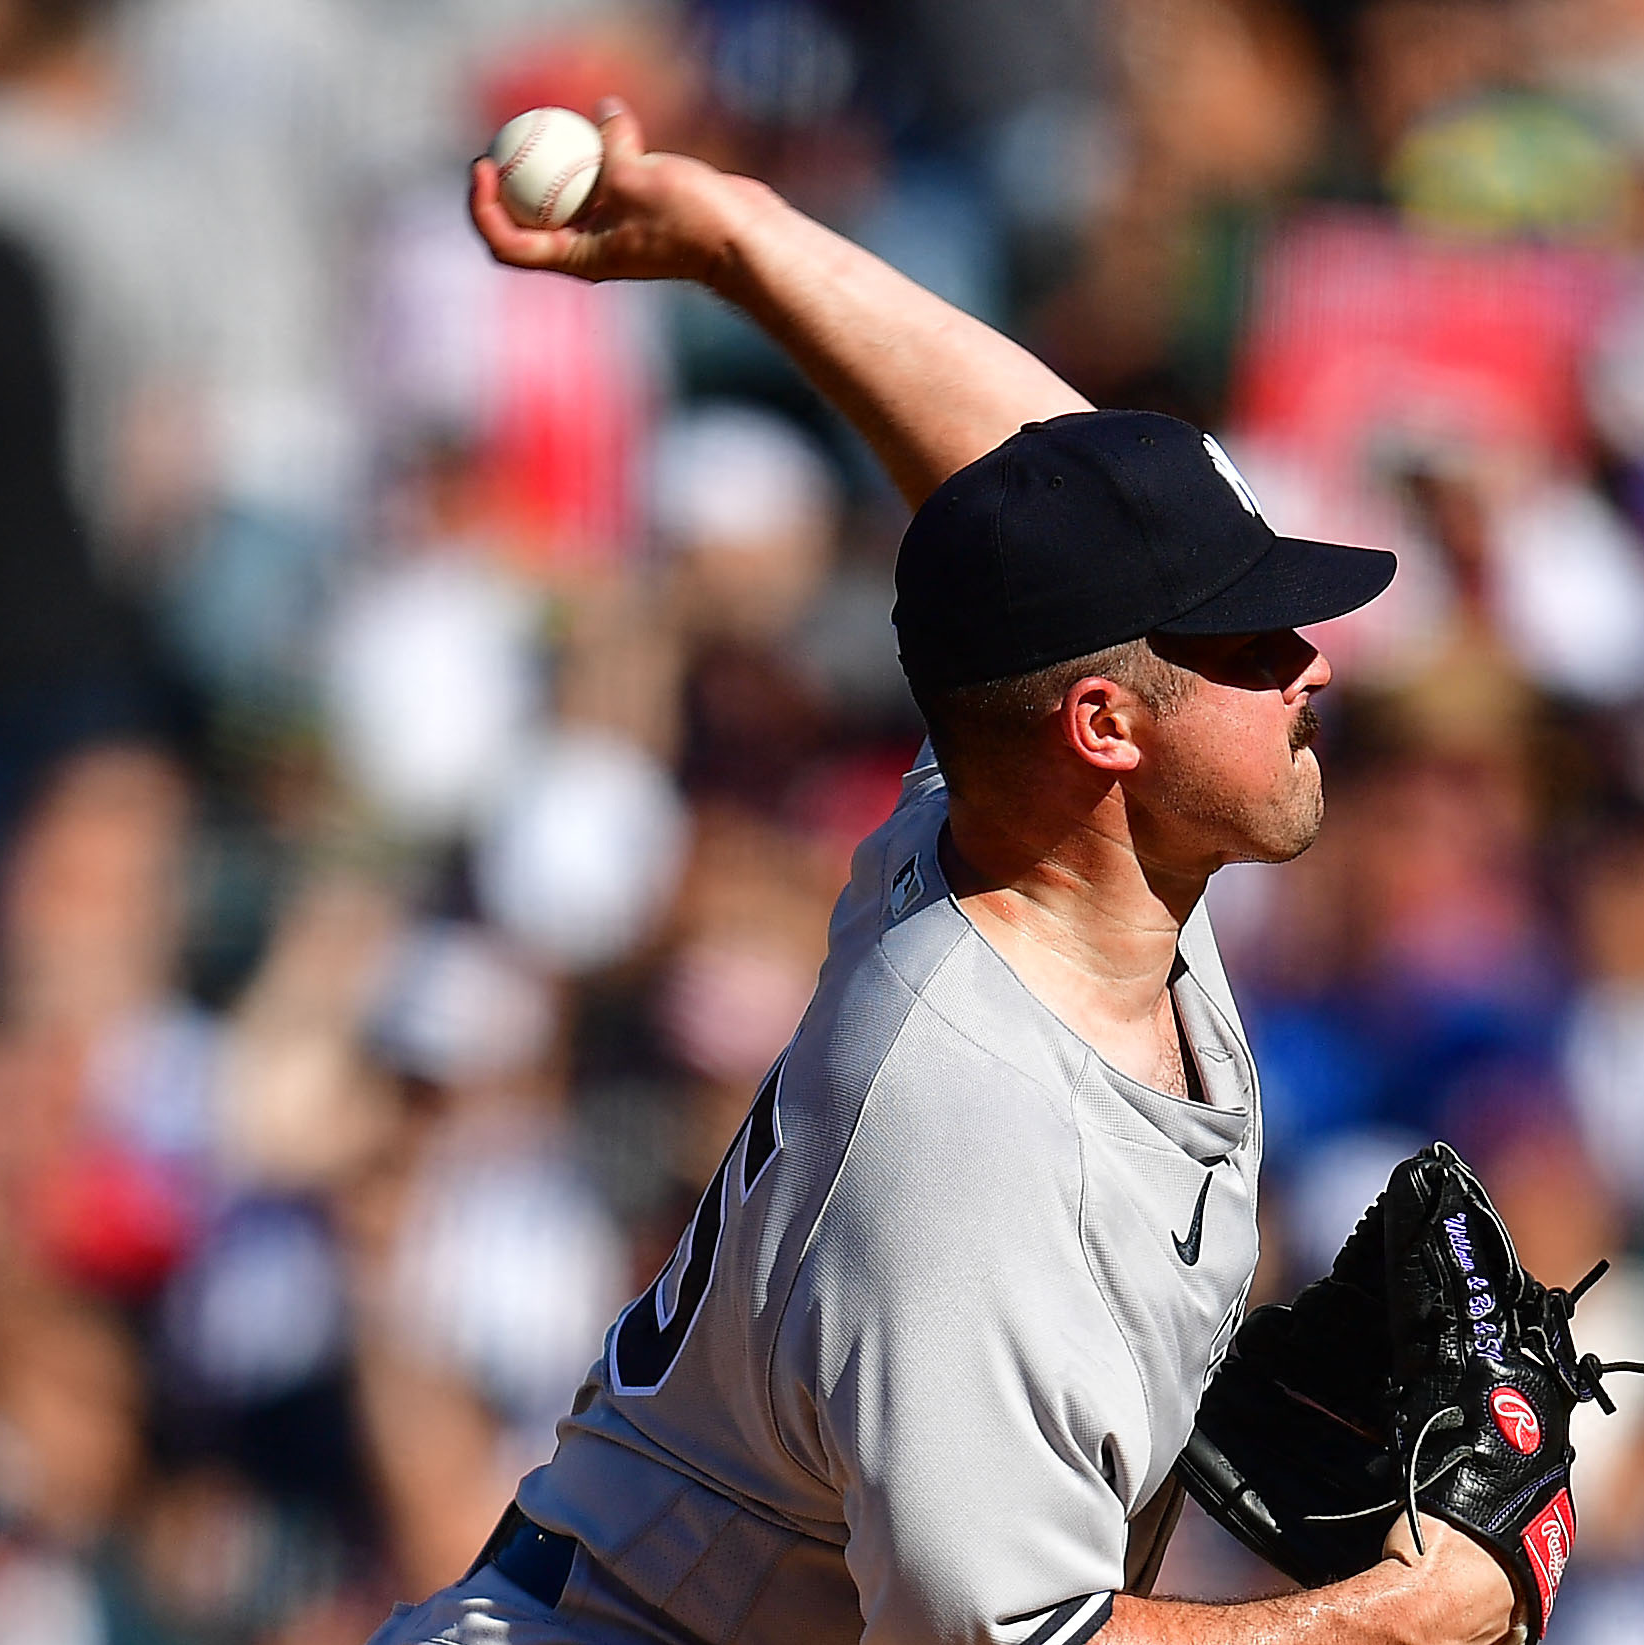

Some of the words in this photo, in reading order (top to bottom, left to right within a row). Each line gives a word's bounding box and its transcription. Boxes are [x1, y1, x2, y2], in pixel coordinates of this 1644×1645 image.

[1466, 1276, 1489, 1291] &
[1468, 1293, 1493, 1315] Bo
[1473, 1321, 1497, 1335] &
[1494, 1394, 1537, 1450] R
